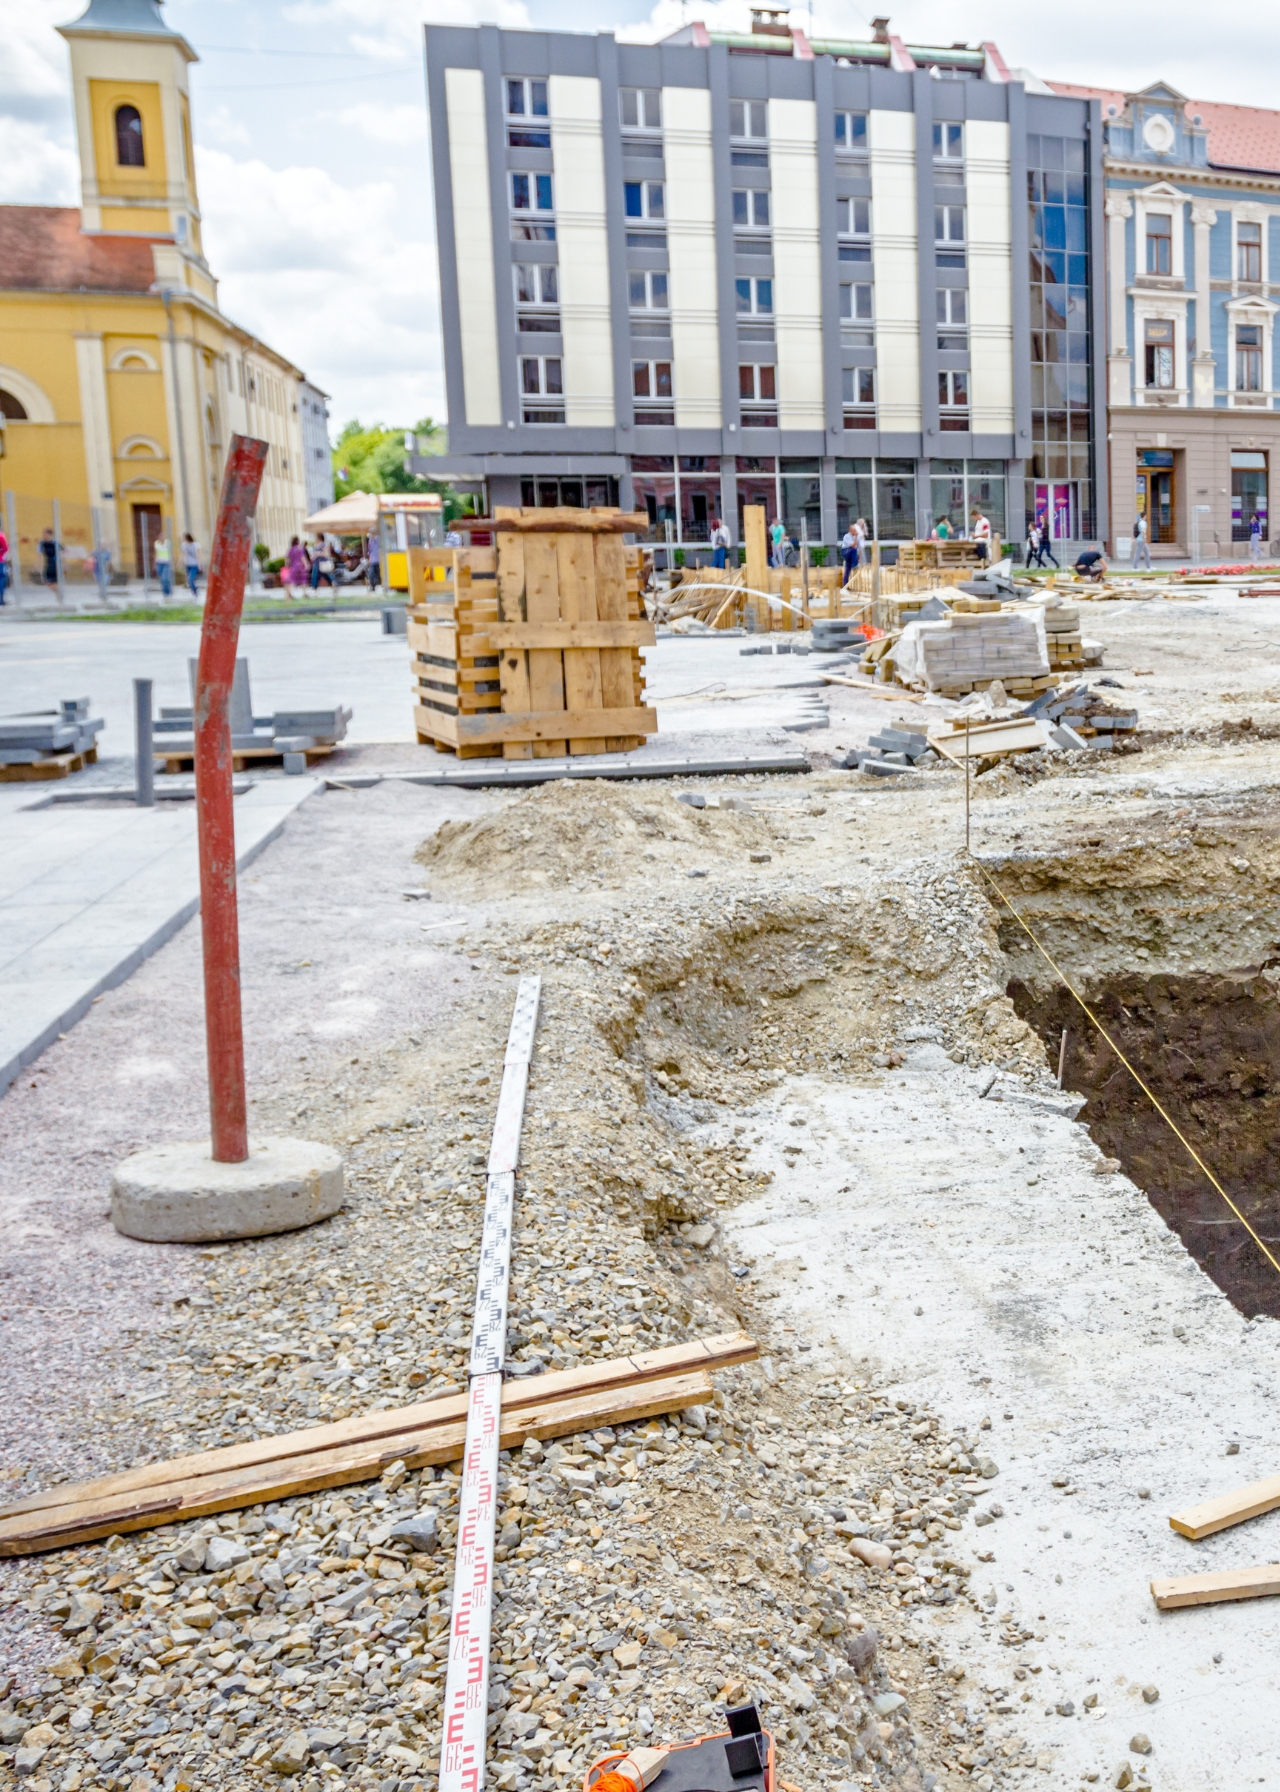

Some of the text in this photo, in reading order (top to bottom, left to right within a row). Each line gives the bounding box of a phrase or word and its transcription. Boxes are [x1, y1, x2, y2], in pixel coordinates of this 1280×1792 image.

[491, 1276, 504, 1287] 26
[478, 1299, 491, 1311] 27
[488, 1320, 501, 1332] 28
[474, 1347, 487, 1360] 29
[481, 1433, 494, 1450] 32
[465, 1469, 479, 1488] 33
[476, 1503, 491, 1523] 34
[460, 1546, 475, 1567] 35
[471, 1585, 487, 1608] 36
[454, 1635, 469, 1661] 37
[465, 1683, 482, 1711] 38
[445, 1743, 463, 1773] 39
